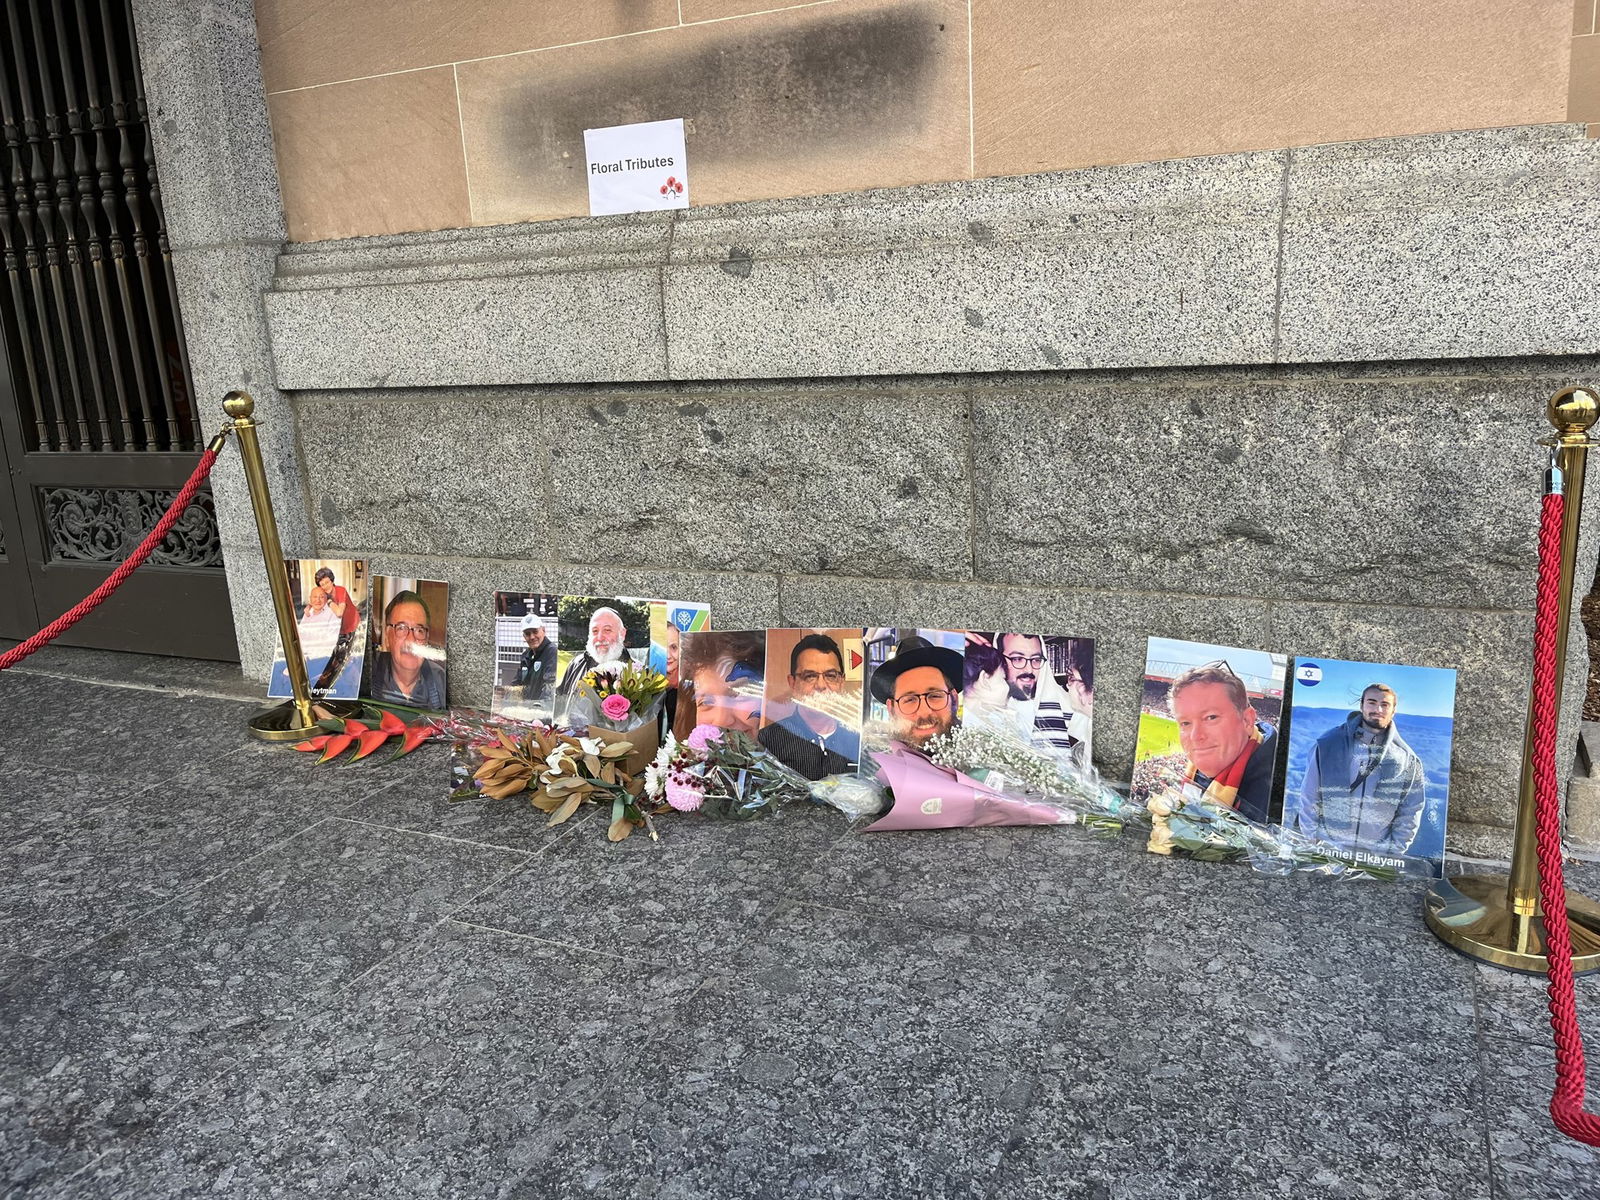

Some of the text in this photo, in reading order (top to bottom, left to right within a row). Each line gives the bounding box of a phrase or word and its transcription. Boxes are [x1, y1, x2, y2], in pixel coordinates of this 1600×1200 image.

[591, 156, 674, 175] Floral Tributes
[1316, 846, 1405, 868] Daniel Elkayam
